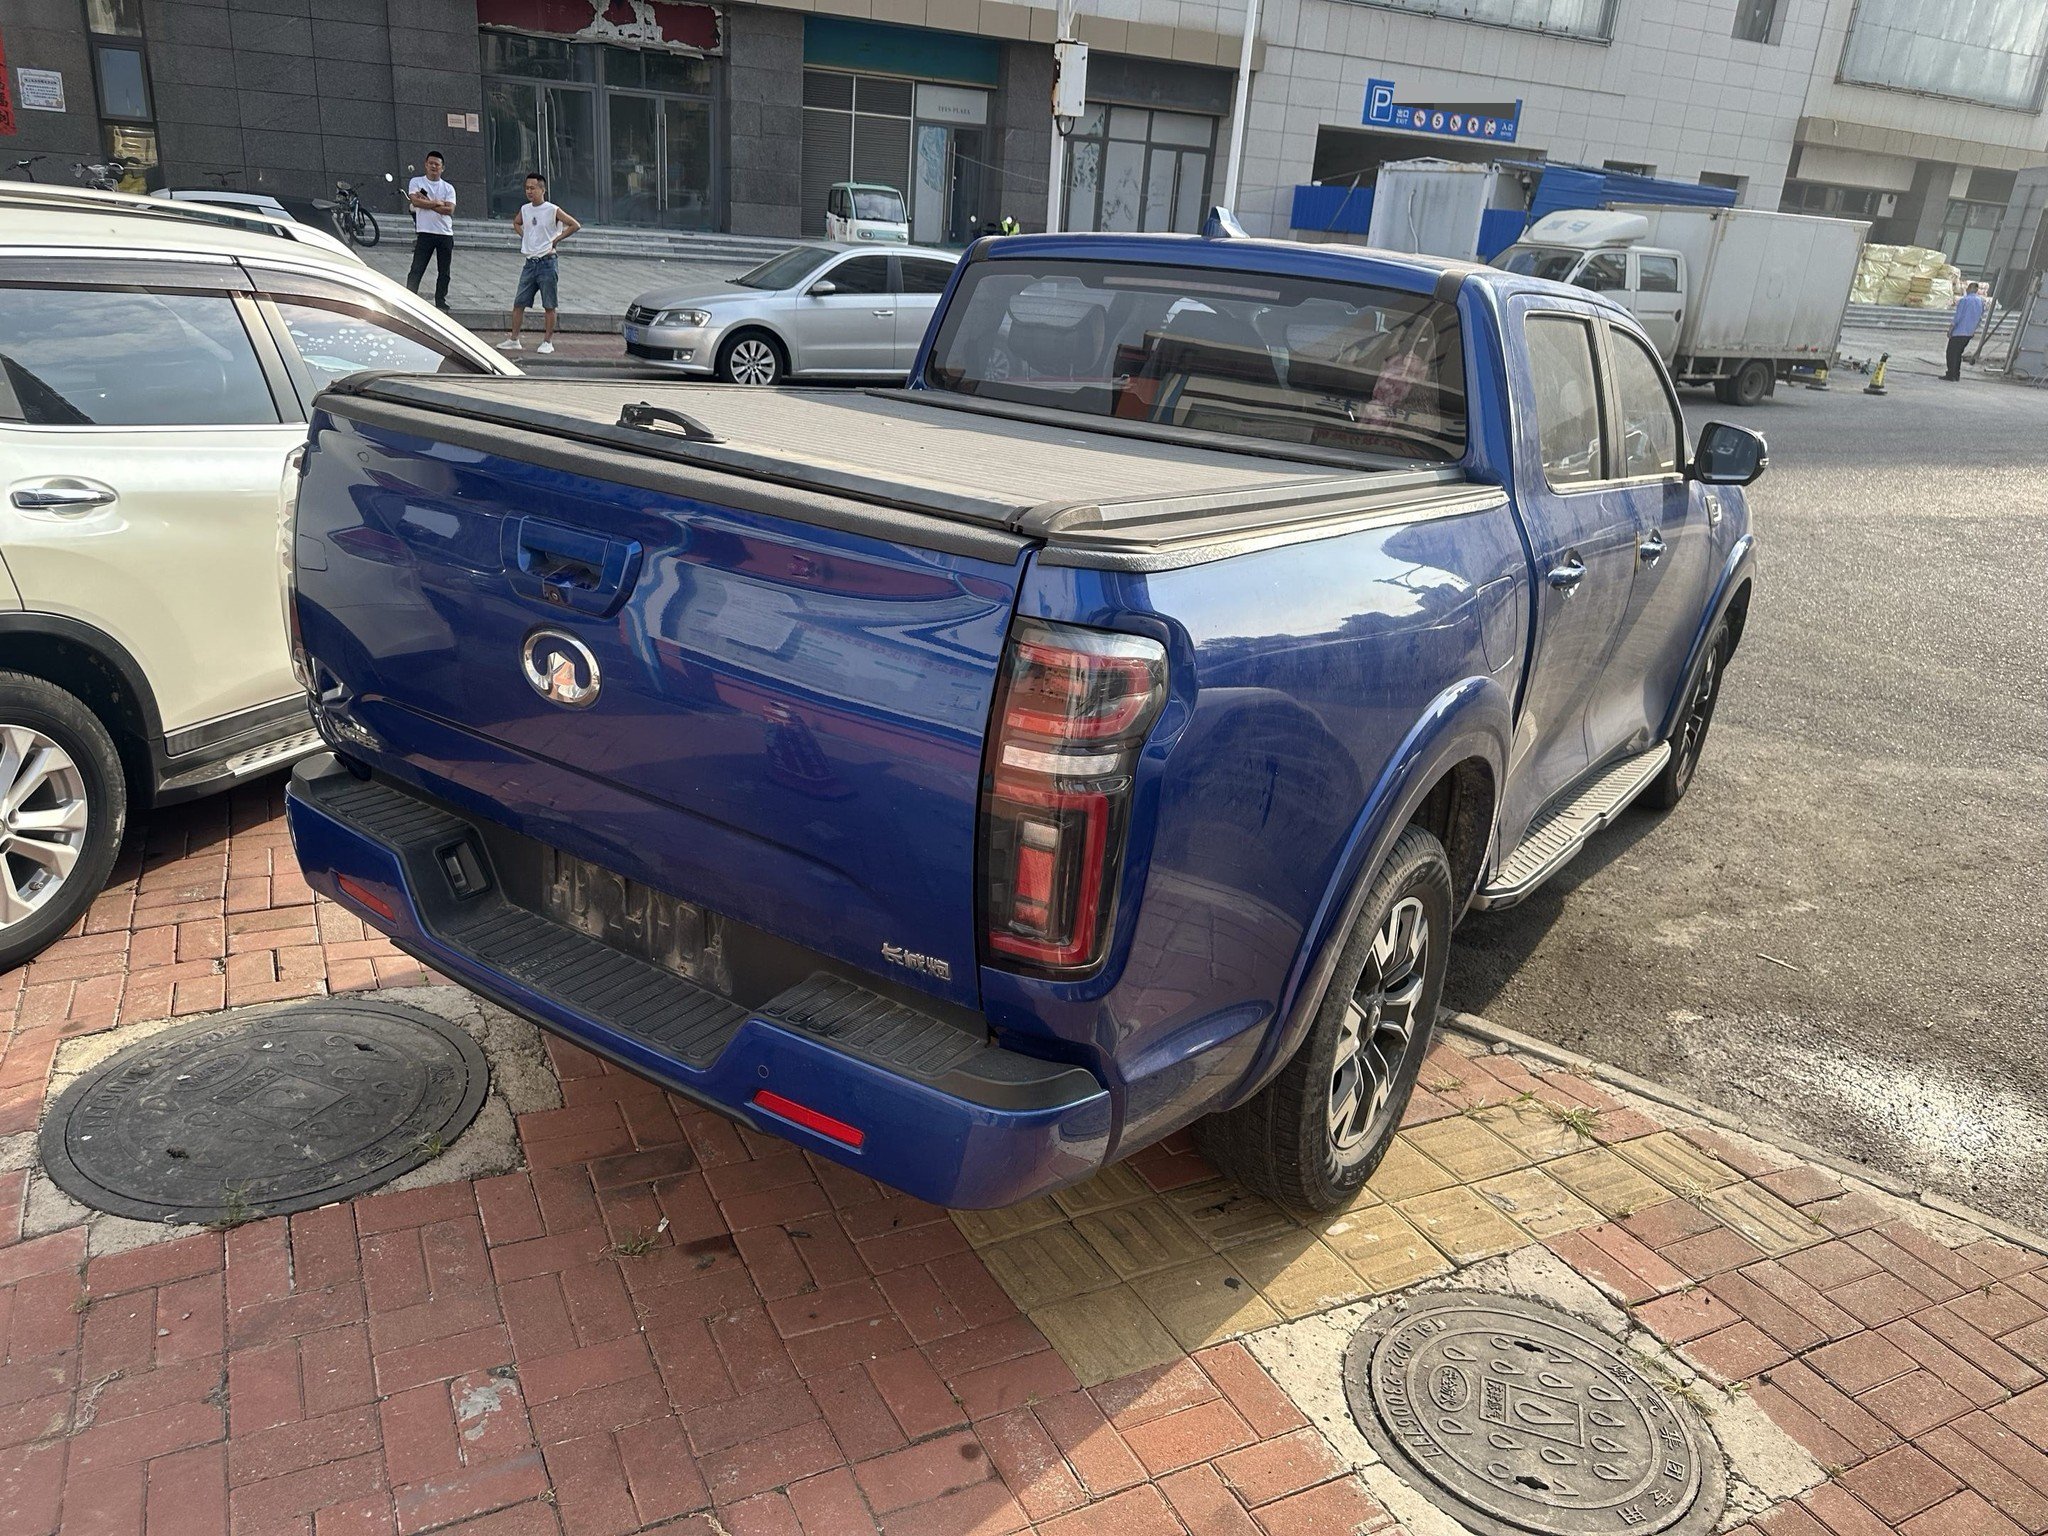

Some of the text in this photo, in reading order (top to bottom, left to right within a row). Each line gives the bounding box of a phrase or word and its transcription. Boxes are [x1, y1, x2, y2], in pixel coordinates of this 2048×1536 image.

[1373, 89, 1391, 117] P
[1434, 115, 1442, 127] 5
[1501, 122, 1513, 131] 入口
